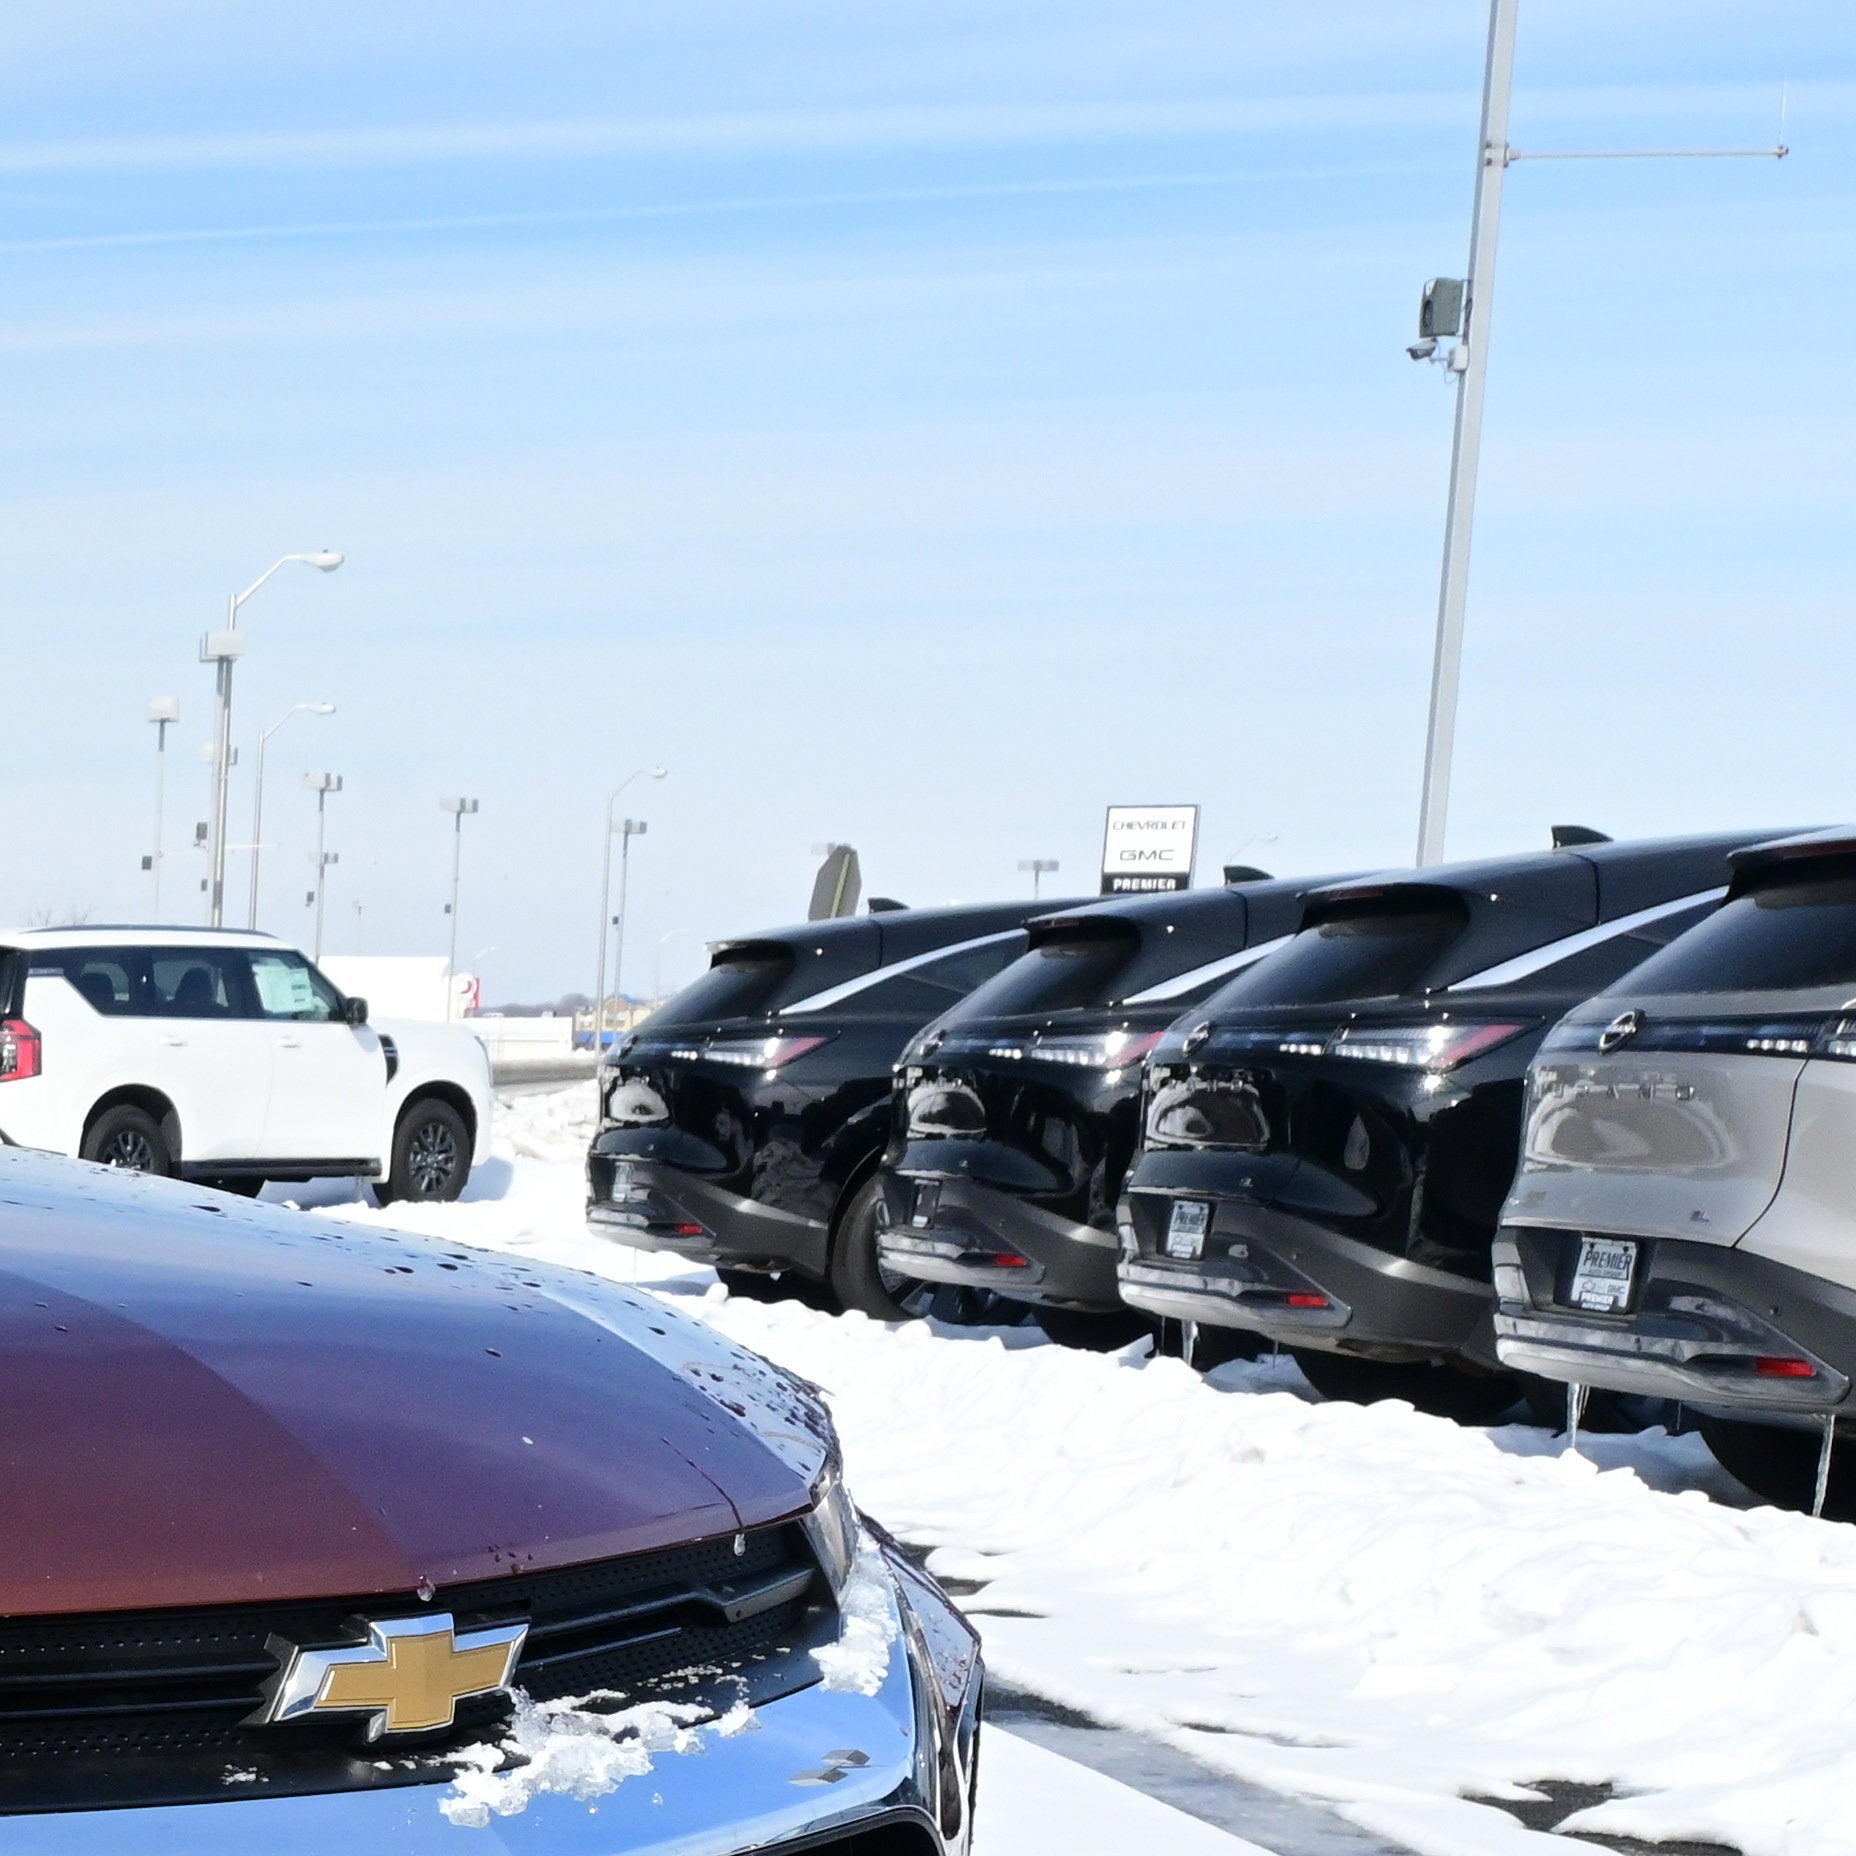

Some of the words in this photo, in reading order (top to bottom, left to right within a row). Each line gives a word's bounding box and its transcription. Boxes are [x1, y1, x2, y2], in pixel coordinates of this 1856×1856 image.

[1112, 820, 1187, 831] CHEVROLET
[1119, 849, 1175, 861] GMC
[1112, 877, 1177, 891] PREMIER
